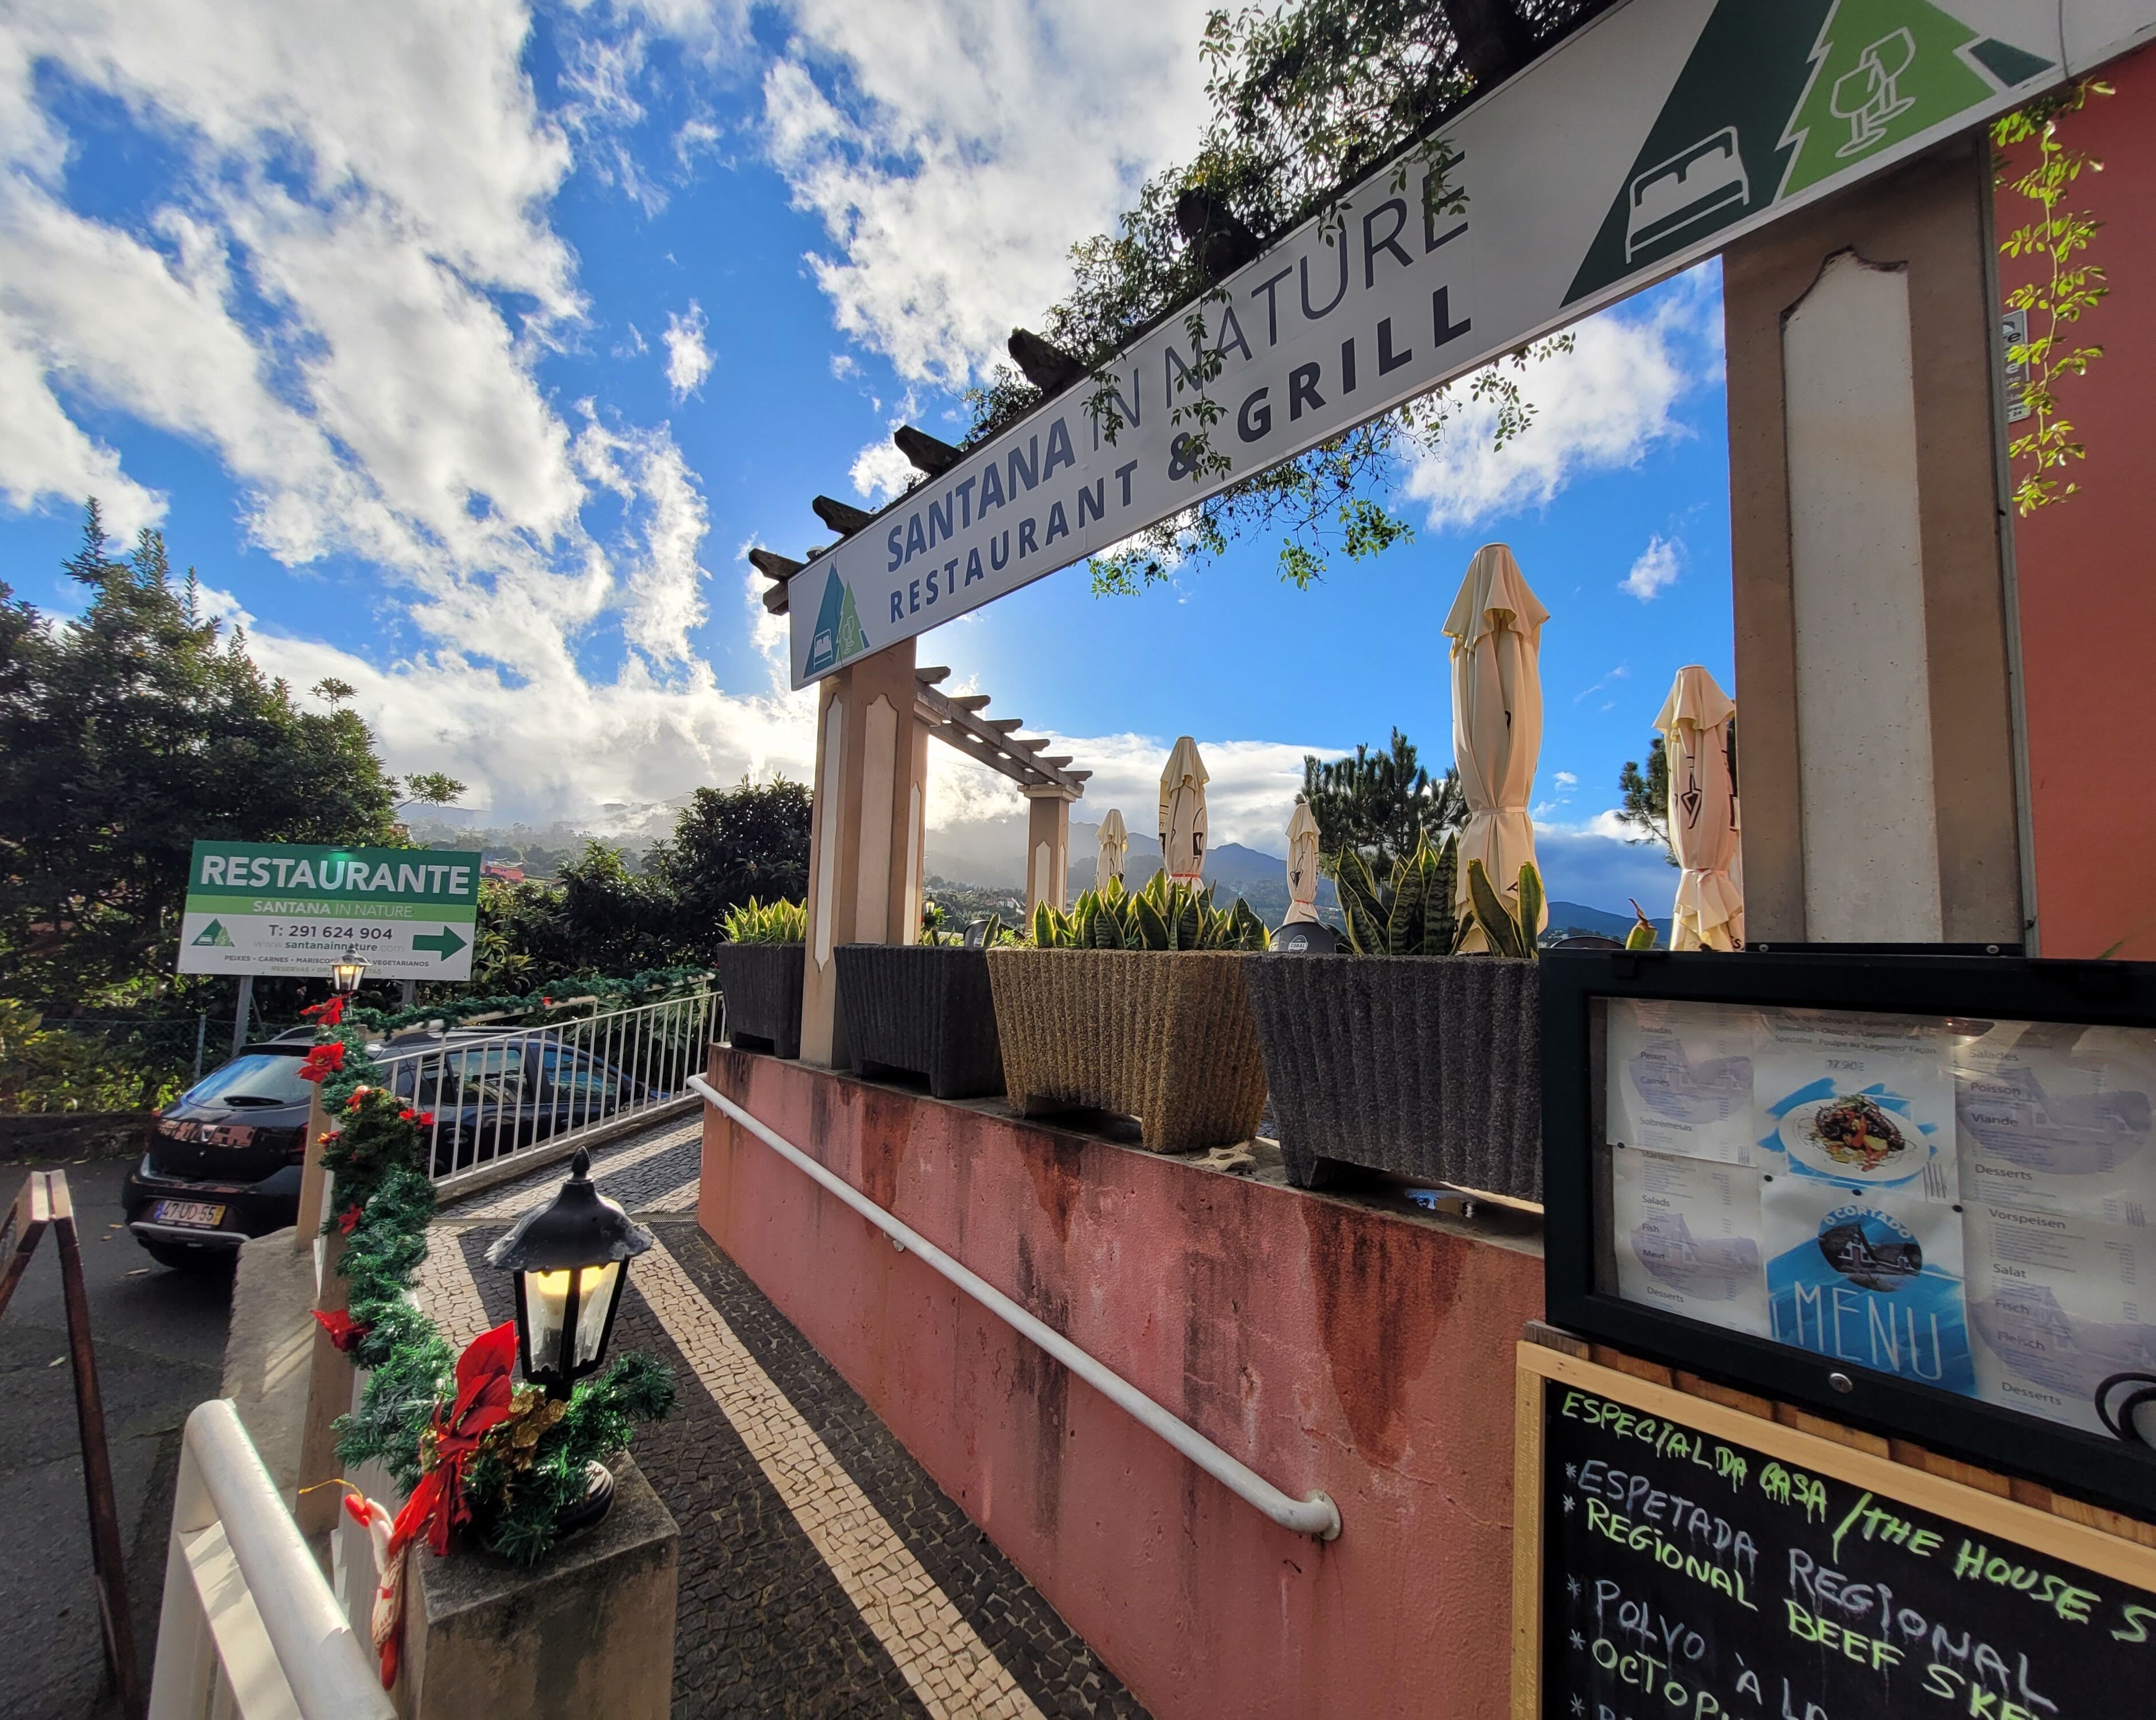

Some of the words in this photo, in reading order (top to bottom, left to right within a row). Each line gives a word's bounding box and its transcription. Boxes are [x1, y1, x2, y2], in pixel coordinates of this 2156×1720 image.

[888, 417, 1076, 572] SANTANA
[1165, 150, 1468, 409] NATURE
[890, 459, 1138, 624] RESTAURANT
[1237, 284, 1471, 443] GRILL
[201, 855, 470, 894] RESTAURANTE
[253, 901, 331, 914] SANTANA
[335, 903, 351, 916] IN
[355, 904, 413, 917] NATURE
[269, 924, 283, 936] T:
[289, 925, 317, 937] 291
[323, 926, 354, 939] 624
[360, 928, 393, 940] 904
[254, 941, 404, 952] www.santanainnture.com
[1970, 1049, 2018, 1061] Salades
[1641, 1076, 1670, 1086] Carnes
[1970, 1082, 2021, 1096] Poisson
[1639, 1117, 1693, 1132] Sobremesas
[1971, 1112, 2018, 1127] Viande
[1975, 1164, 2033, 1180] Desserts
[1642, 1195, 1670, 1207] Salads
[162, 1202, 216, 1221] 47-UD-55
[1988, 1208, 2067, 1229] Vorspeisen
[1642, 1223, 1659, 1233] Fish
[1837, 1205, 1912, 1238] CORTADO
[1643, 1249, 1665, 1260] Meat
[1993, 1263, 2027, 1279] Salat
[1647, 1286, 1684, 1303] Desserts
[1995, 1299, 2030, 1315] Fisch
[1795, 1280, 1942, 1381] MENU
[1998, 1331, 2045, 1351] Fleisch
[2002, 1382, 2062, 1405] Desserts
[1561, 1391, 1713, 1470] ESPECIAL
[1760, 1462, 1827, 1522] CASA
[1954, 1539, 2103, 1625] HOUSE
[1578, 1459, 1759, 1566] ESPETADA
[1788, 1549, 2059, 1713] REGIONAL
[1596, 1580, 1705, 1660] POLVO
[1784, 1598, 1906, 1671] BEEF
